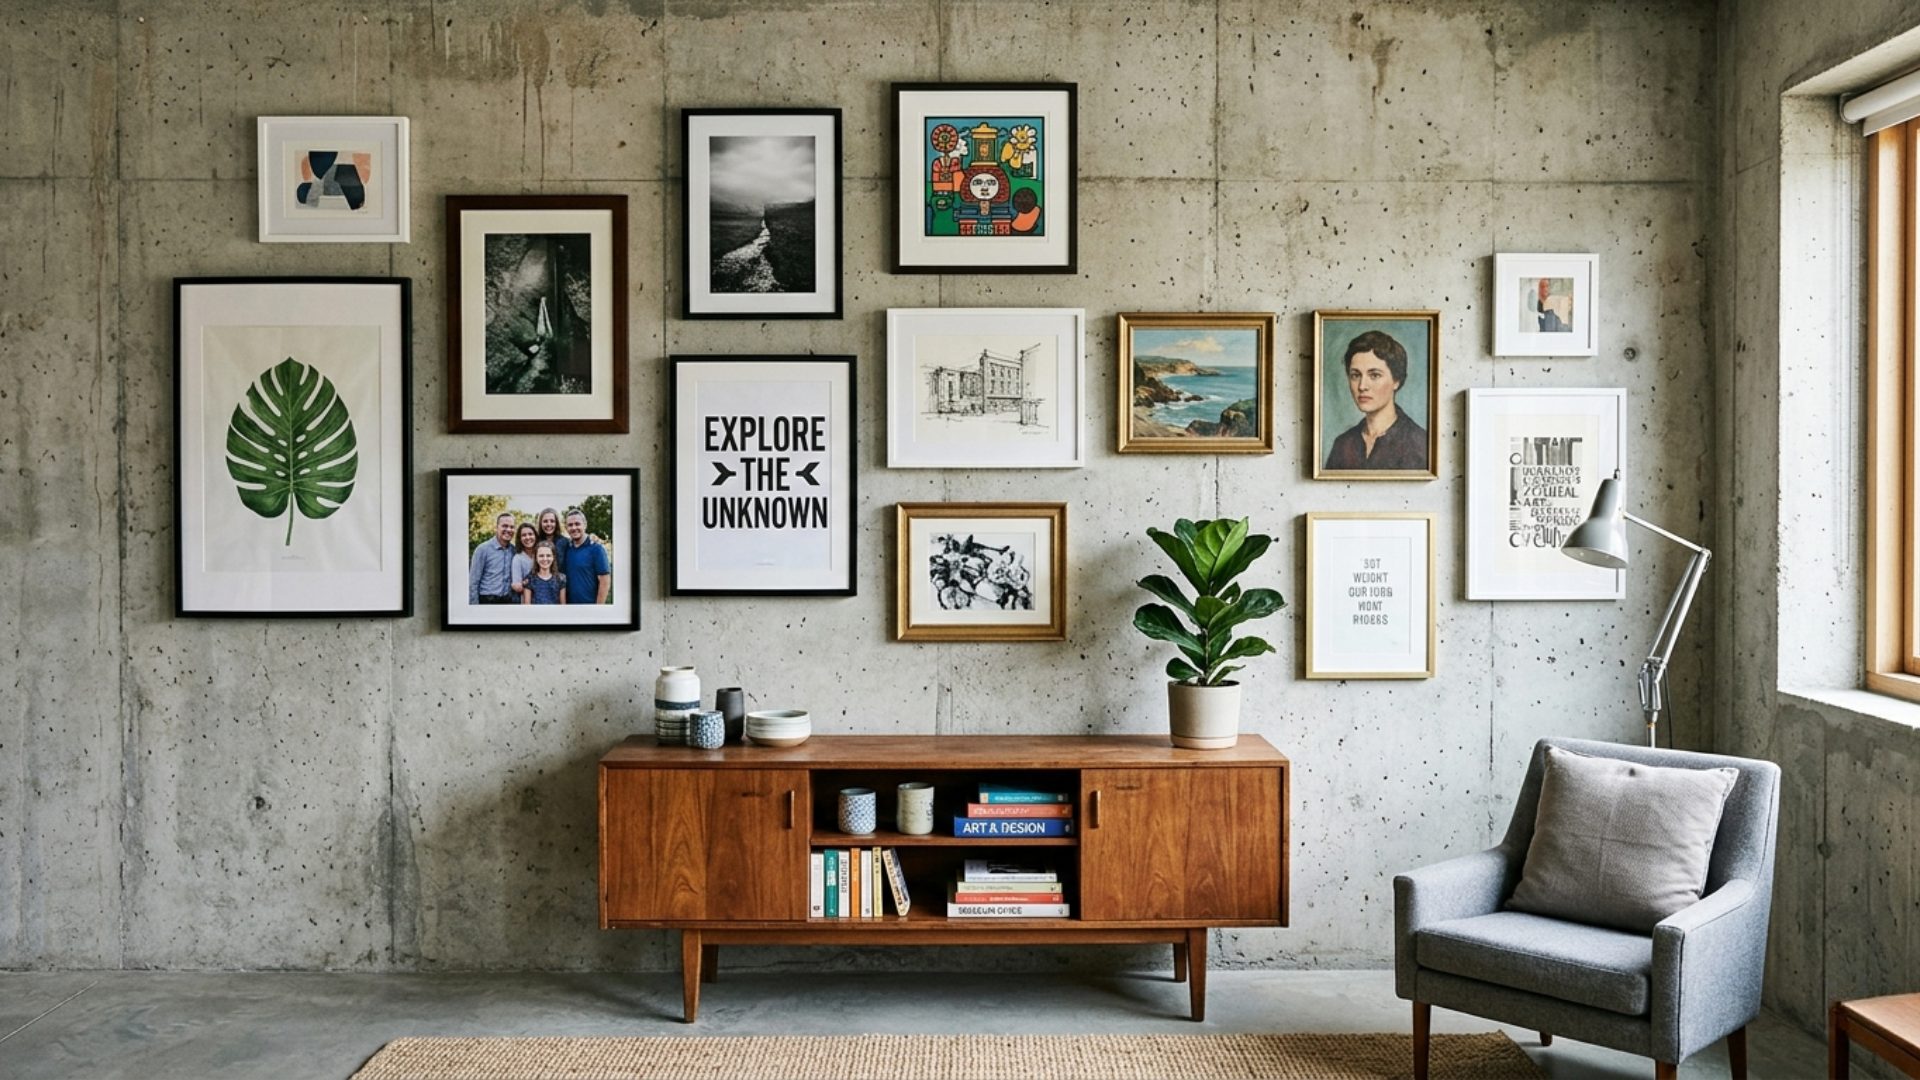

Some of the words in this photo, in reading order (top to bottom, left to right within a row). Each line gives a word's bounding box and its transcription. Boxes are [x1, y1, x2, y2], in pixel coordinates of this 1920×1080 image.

[704, 416, 826, 452] EXPLORE
[740, 457, 791, 492] THE
[702, 496, 828, 530] UNKNOWN
[962, 822, 988, 834] ART
